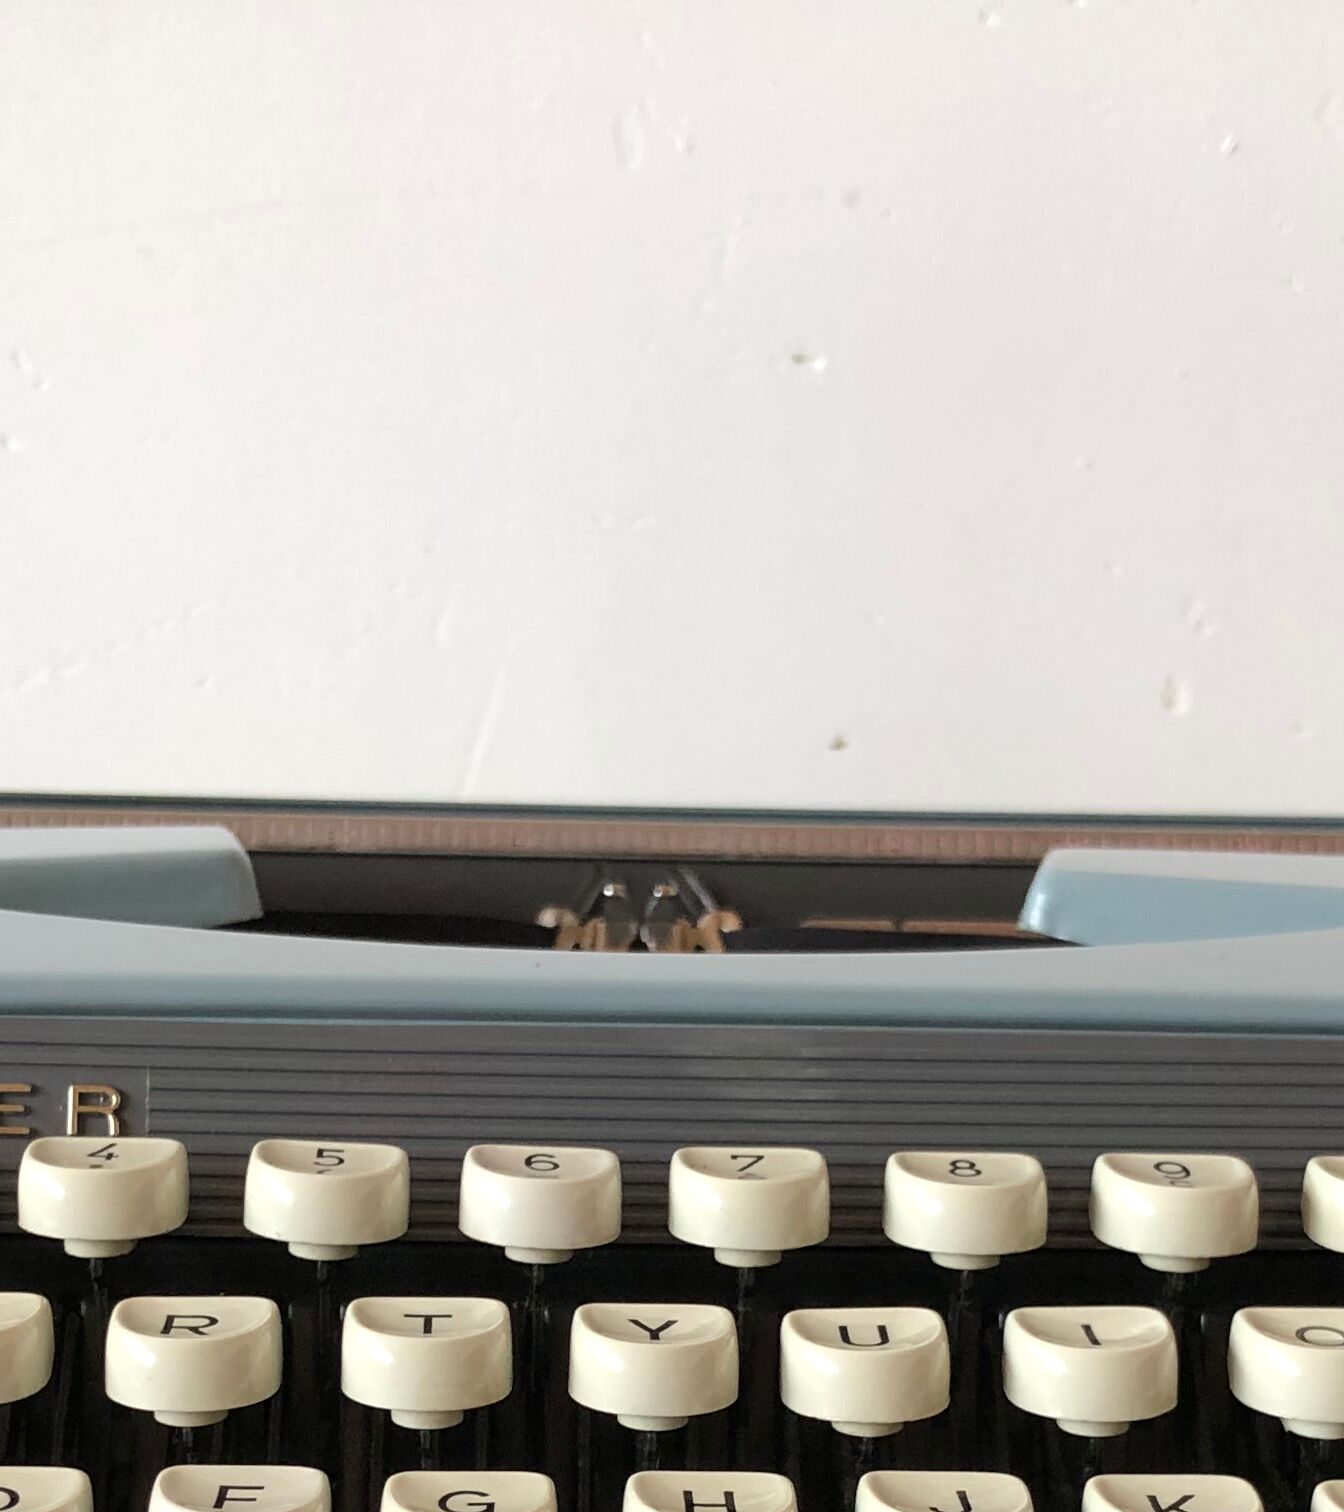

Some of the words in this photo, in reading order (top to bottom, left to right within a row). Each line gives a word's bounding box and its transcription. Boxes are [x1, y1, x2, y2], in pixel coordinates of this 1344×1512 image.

[87, 1143, 118, 1161] 4
[314, 1148, 345, 1167] 5
[524, 1153, 560, 1172] 6
[730, 1154, 765, 1173] 7
[948, 1159, 982, 1178] 8
[1153, 1161, 1191, 1180] 9
[159, 1314, 219, 1336] R
[403, 1313, 453, 1335] T
[627, 1318, 678, 1341] Y
[838, 1324, 890, 1347] U
[212, 1485, 265, 1510] F
